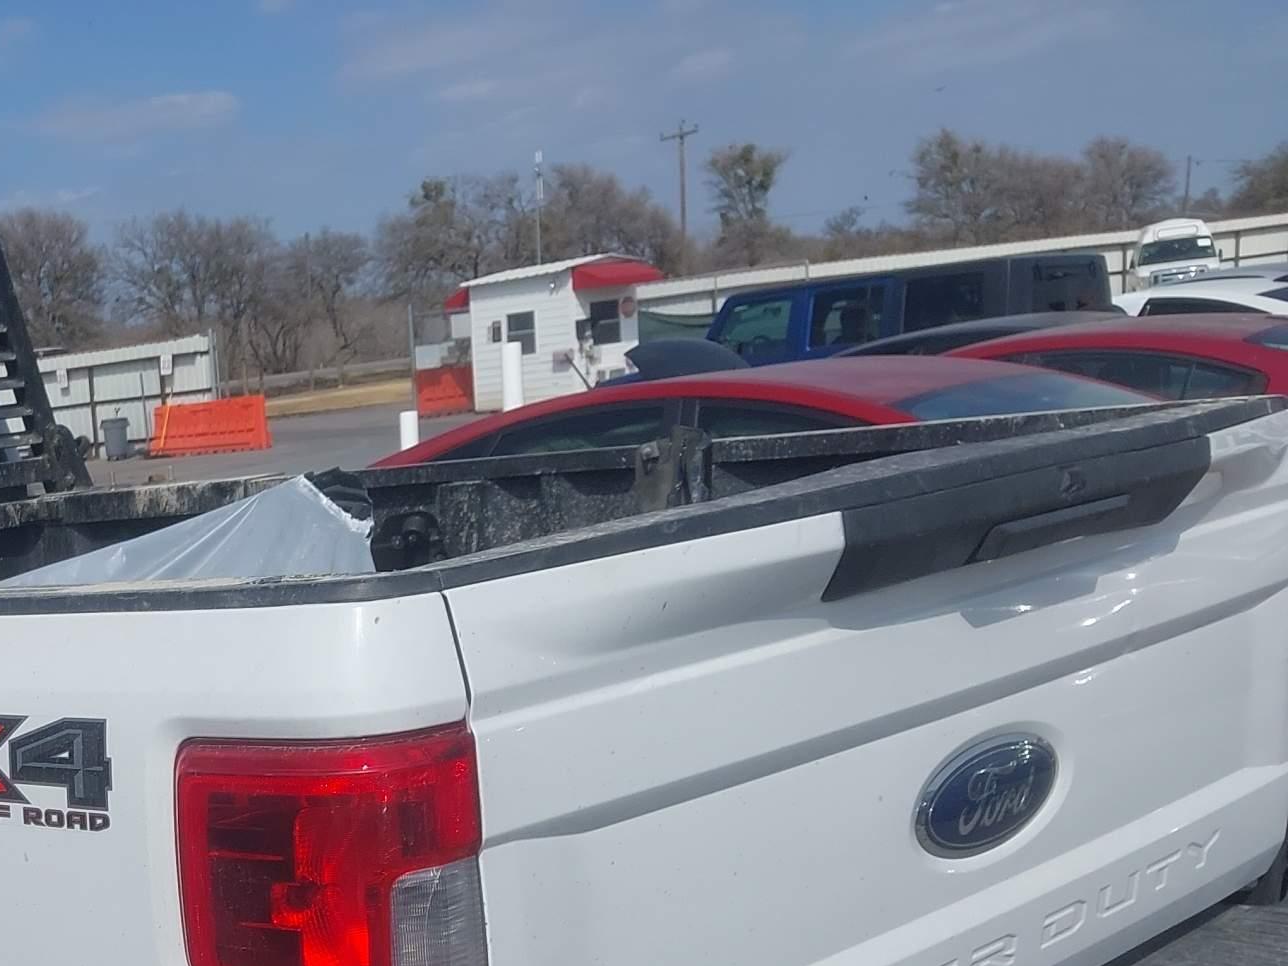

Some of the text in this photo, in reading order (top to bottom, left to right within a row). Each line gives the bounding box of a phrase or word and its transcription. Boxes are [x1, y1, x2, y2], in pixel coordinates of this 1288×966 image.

[23, 806, 110, 832] ROAD
[959, 760, 1035, 836] Ford
[1040, 829, 1221, 950] DUTY
